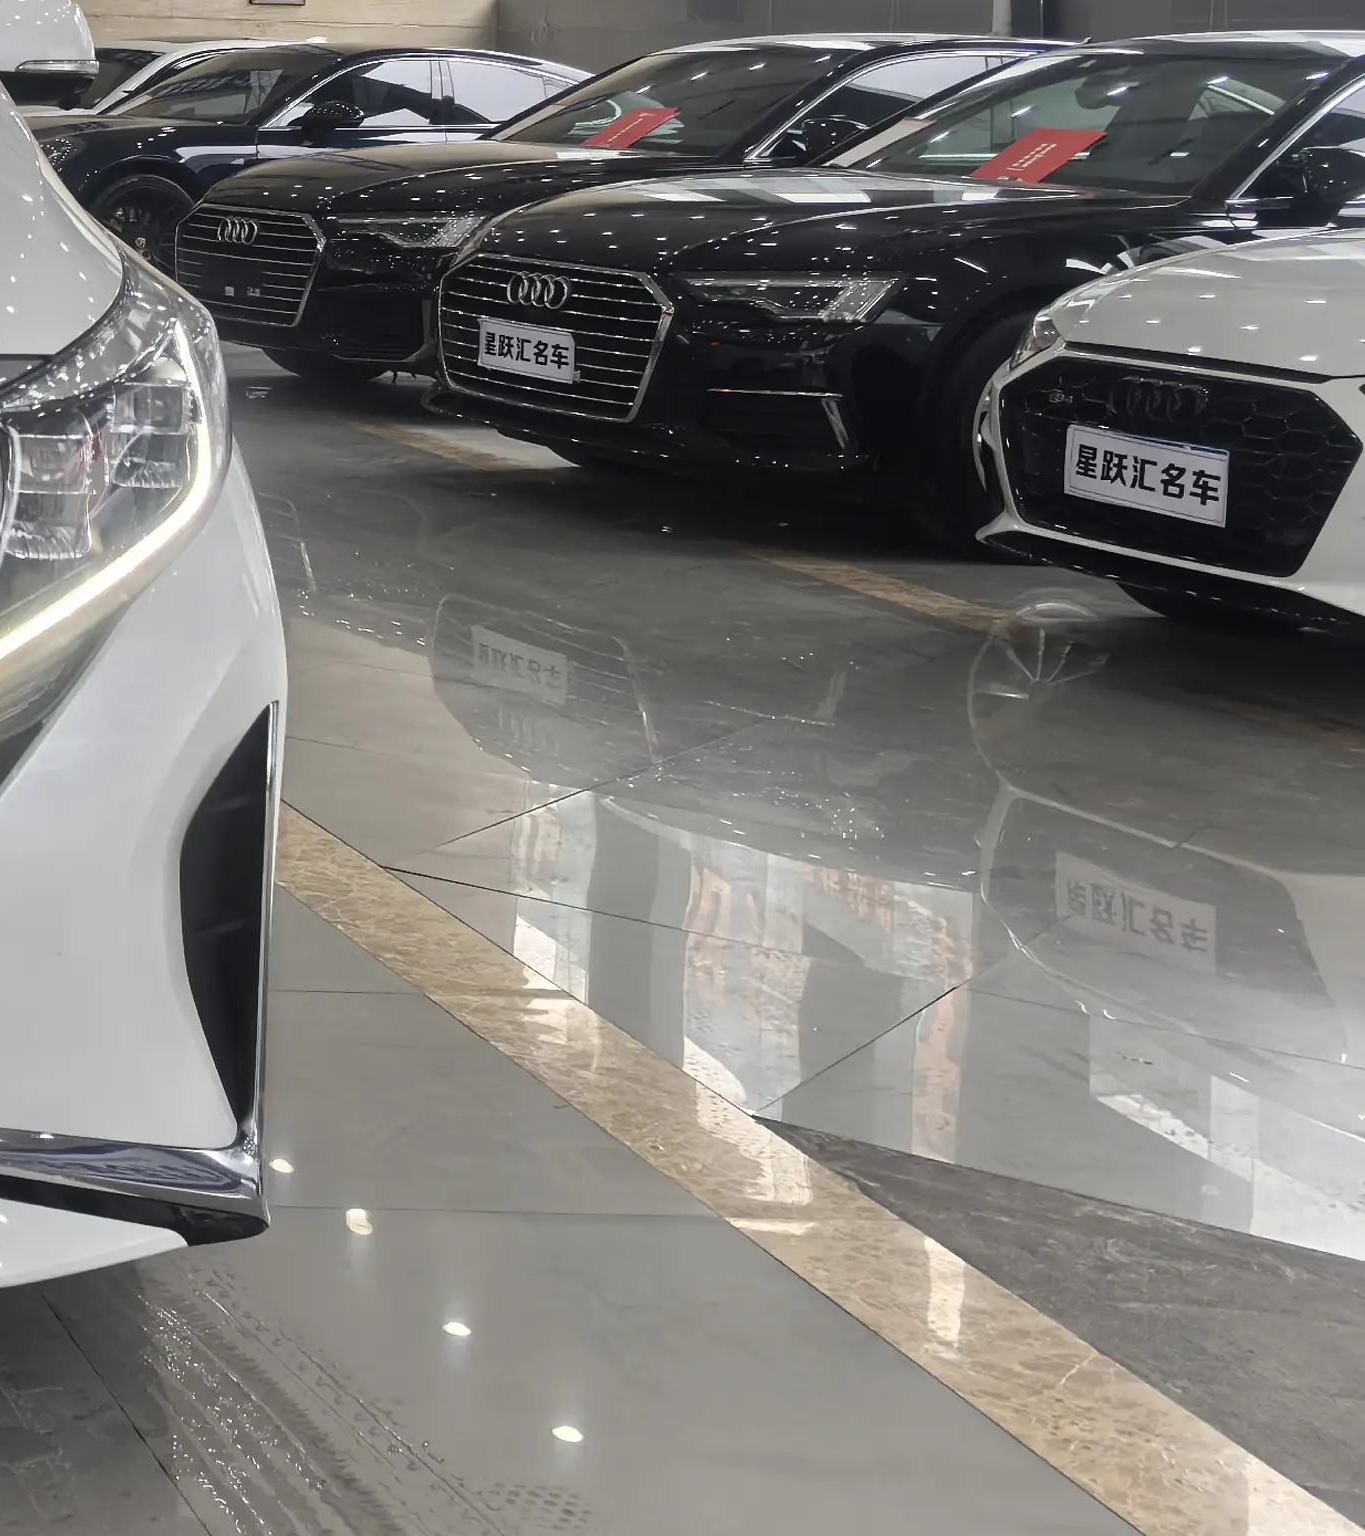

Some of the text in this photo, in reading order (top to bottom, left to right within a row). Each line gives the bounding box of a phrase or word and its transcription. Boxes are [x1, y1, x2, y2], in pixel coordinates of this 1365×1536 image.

[484, 331, 570, 369] 星跃汇名车
[1075, 444, 1222, 506] 星跃汇名车
